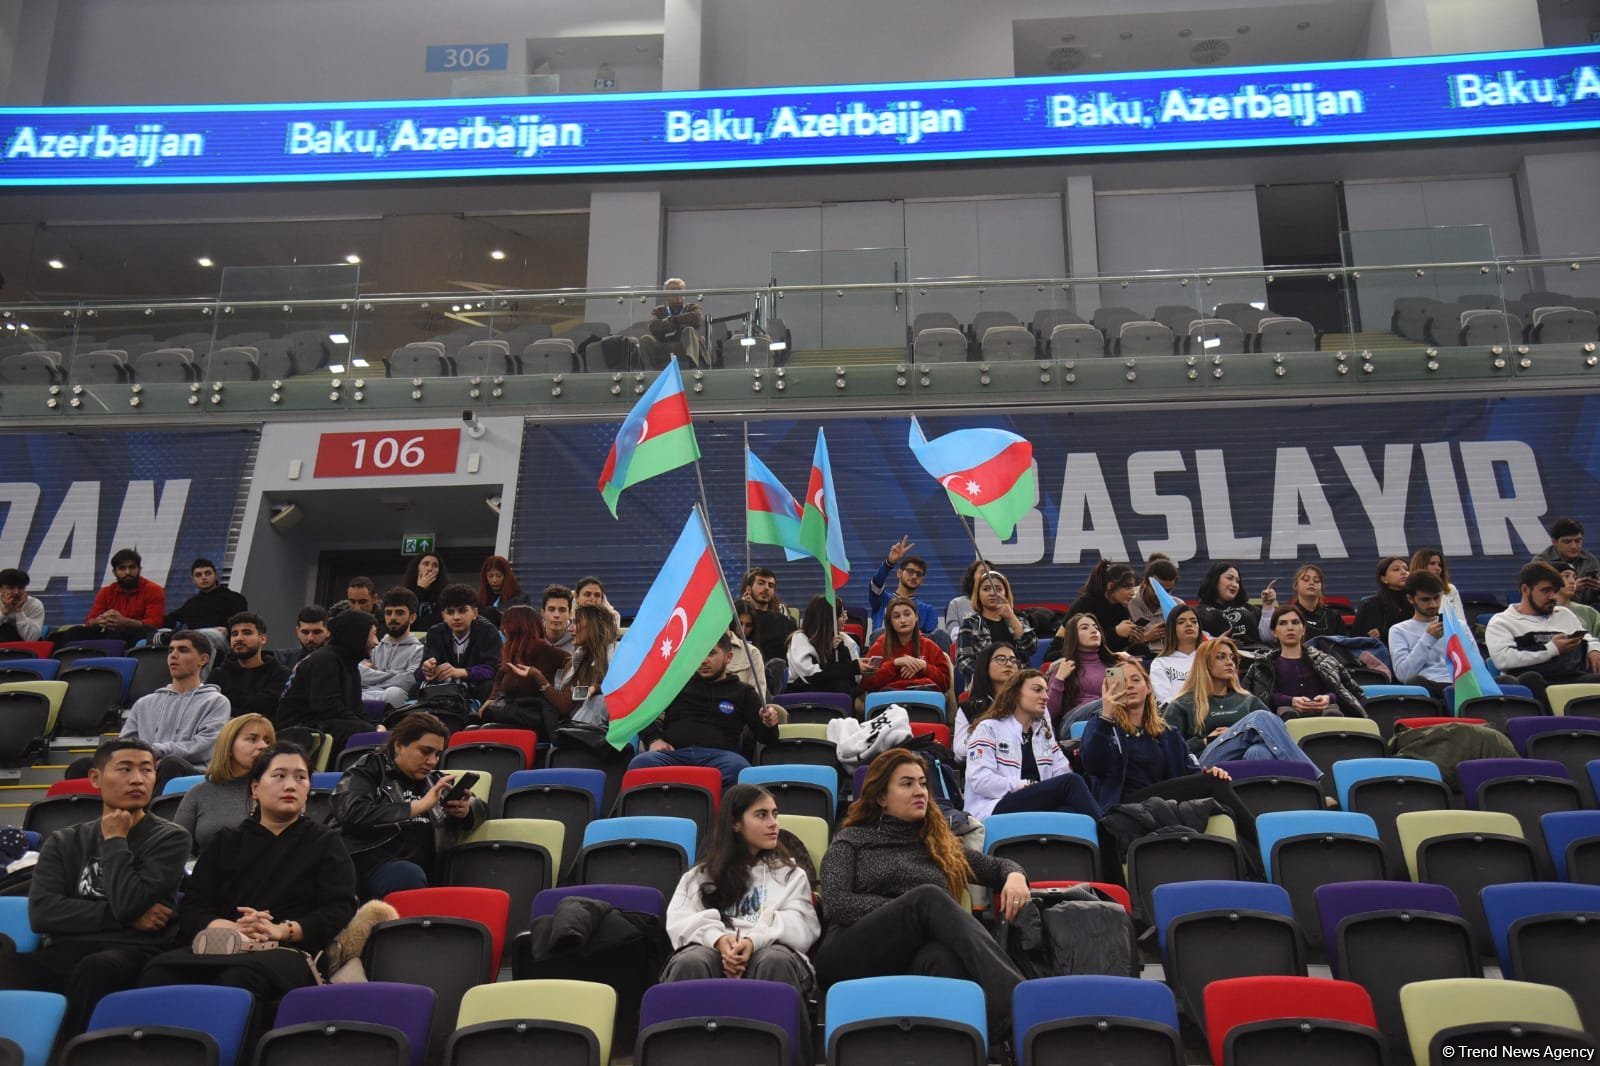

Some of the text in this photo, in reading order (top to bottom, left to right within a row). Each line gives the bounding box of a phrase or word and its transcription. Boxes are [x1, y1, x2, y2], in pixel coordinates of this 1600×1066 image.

[443, 47, 490, 68] 306
[1052, 82, 1364, 128] Baku, Azerbaijan
[1454, 70, 1567, 107] Baku,
[288, 115, 582, 158] Baku, Azerbaijan
[665, 101, 964, 144] Baku, Azerbaijan
[7, 125, 204, 167] Azerbaijan
[351, 436, 425, 469] 106
